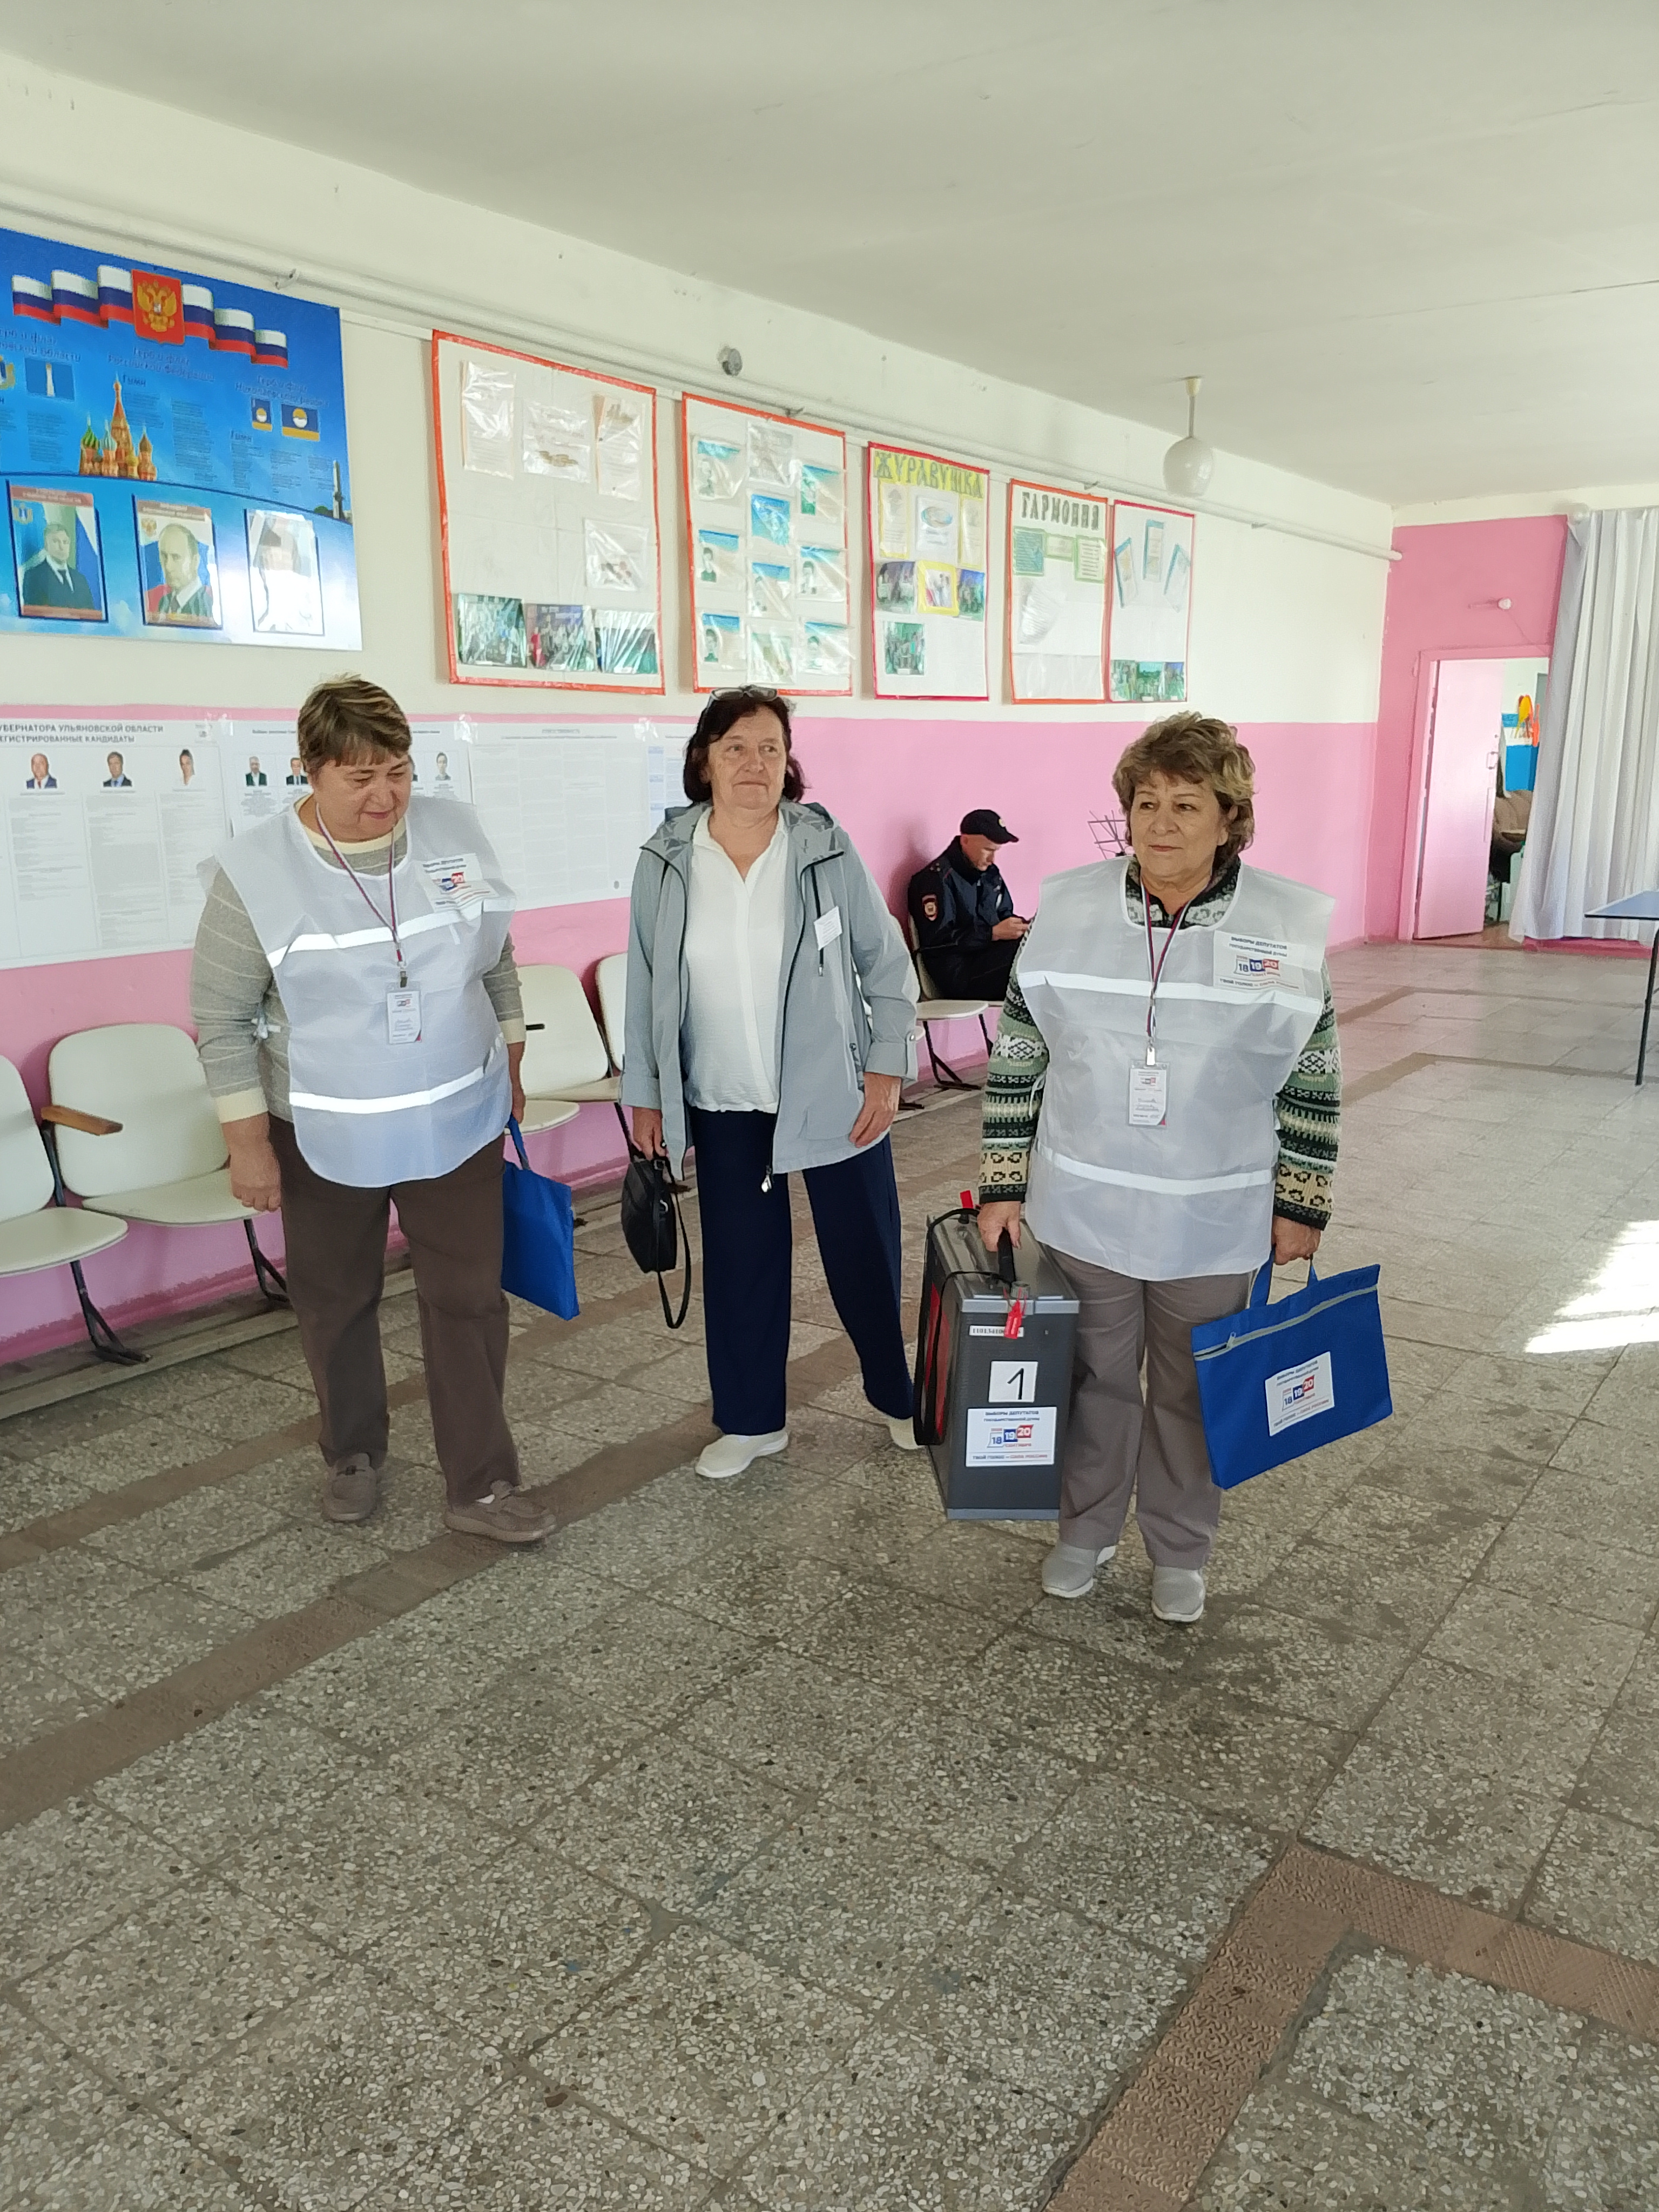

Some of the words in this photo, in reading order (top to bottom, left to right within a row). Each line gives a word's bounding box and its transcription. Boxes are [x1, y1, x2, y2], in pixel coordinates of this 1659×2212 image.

[873, 450, 983, 498] ЖУРАВУШКА
[1021, 491, 1100, 530] ГАРМОНИЯ
[58, 723, 123, 732] УЛЬЯНОВСКОЙ
[125, 725, 164, 733] ОБЛАСТИ
[85, 735, 135, 743] КАНДИДАТЫ
[1238, 963, 1249, 973] 18
[1250, 962, 1262, 970] 19
[1264, 960, 1278, 968] 20
[1007, 1367, 1024, 1400] 1
[1303, 1379, 1314, 1390] 20
[1293, 1387, 1303, 1398] 19
[1284, 1396, 1293, 1406] 18
[1004, 1432, 1015, 1441] 19
[1017, 1427, 1031, 1437] 20
